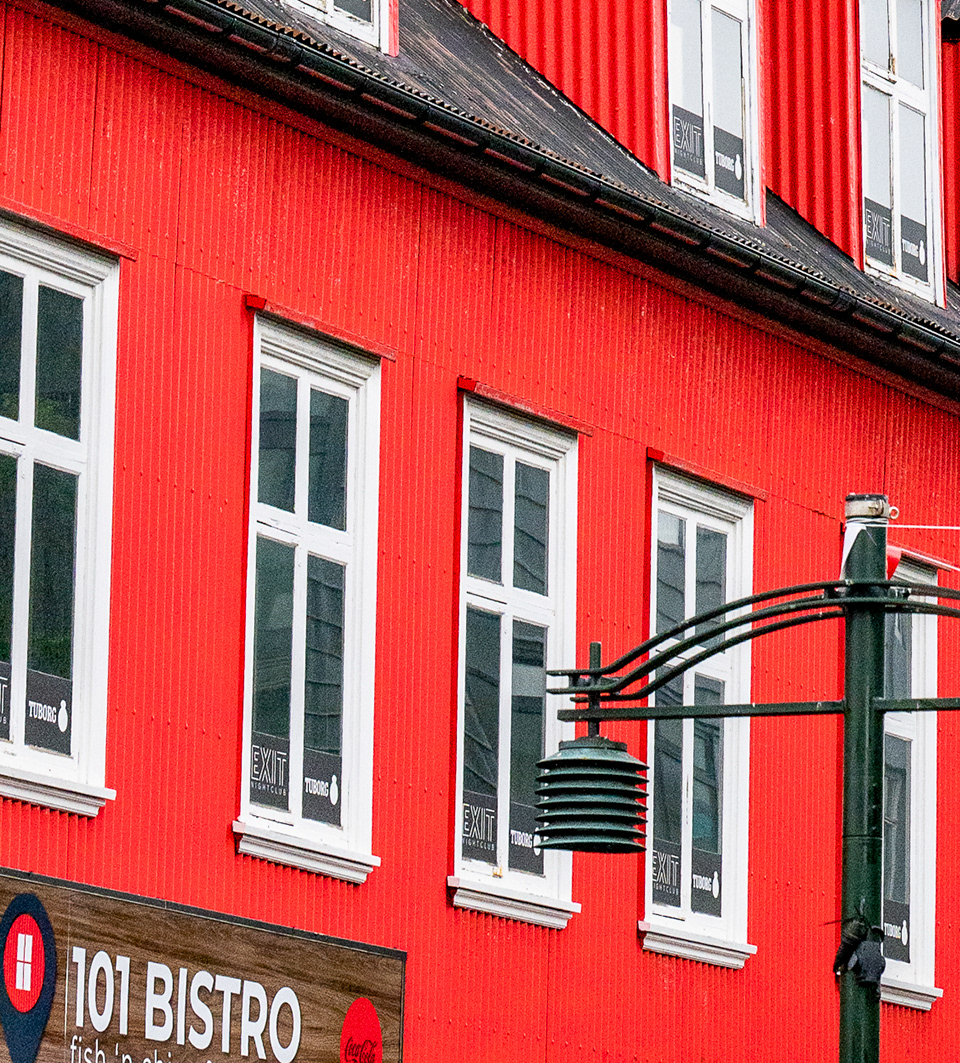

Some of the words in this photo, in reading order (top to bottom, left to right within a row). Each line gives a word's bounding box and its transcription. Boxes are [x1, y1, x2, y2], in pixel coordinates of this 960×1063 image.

[674, 115, 702, 158] EXIT
[866, 209, 891, 247] EXIT
[29, 700, 57, 724] TUBORG
[252, 744, 287, 787] EXIT
[251, 781, 287, 796] NIGHTCLUB
[305, 777, 330, 798] TUBORG
[462, 803, 495, 842] EXIT
[510, 829, 533, 848] TUBORG
[653, 850, 679, 887] EXIT
[72, 945, 131, 1036] 101
[145, 959, 302, 1063] BISTRO
[71, 1035, 106, 1063] fish
